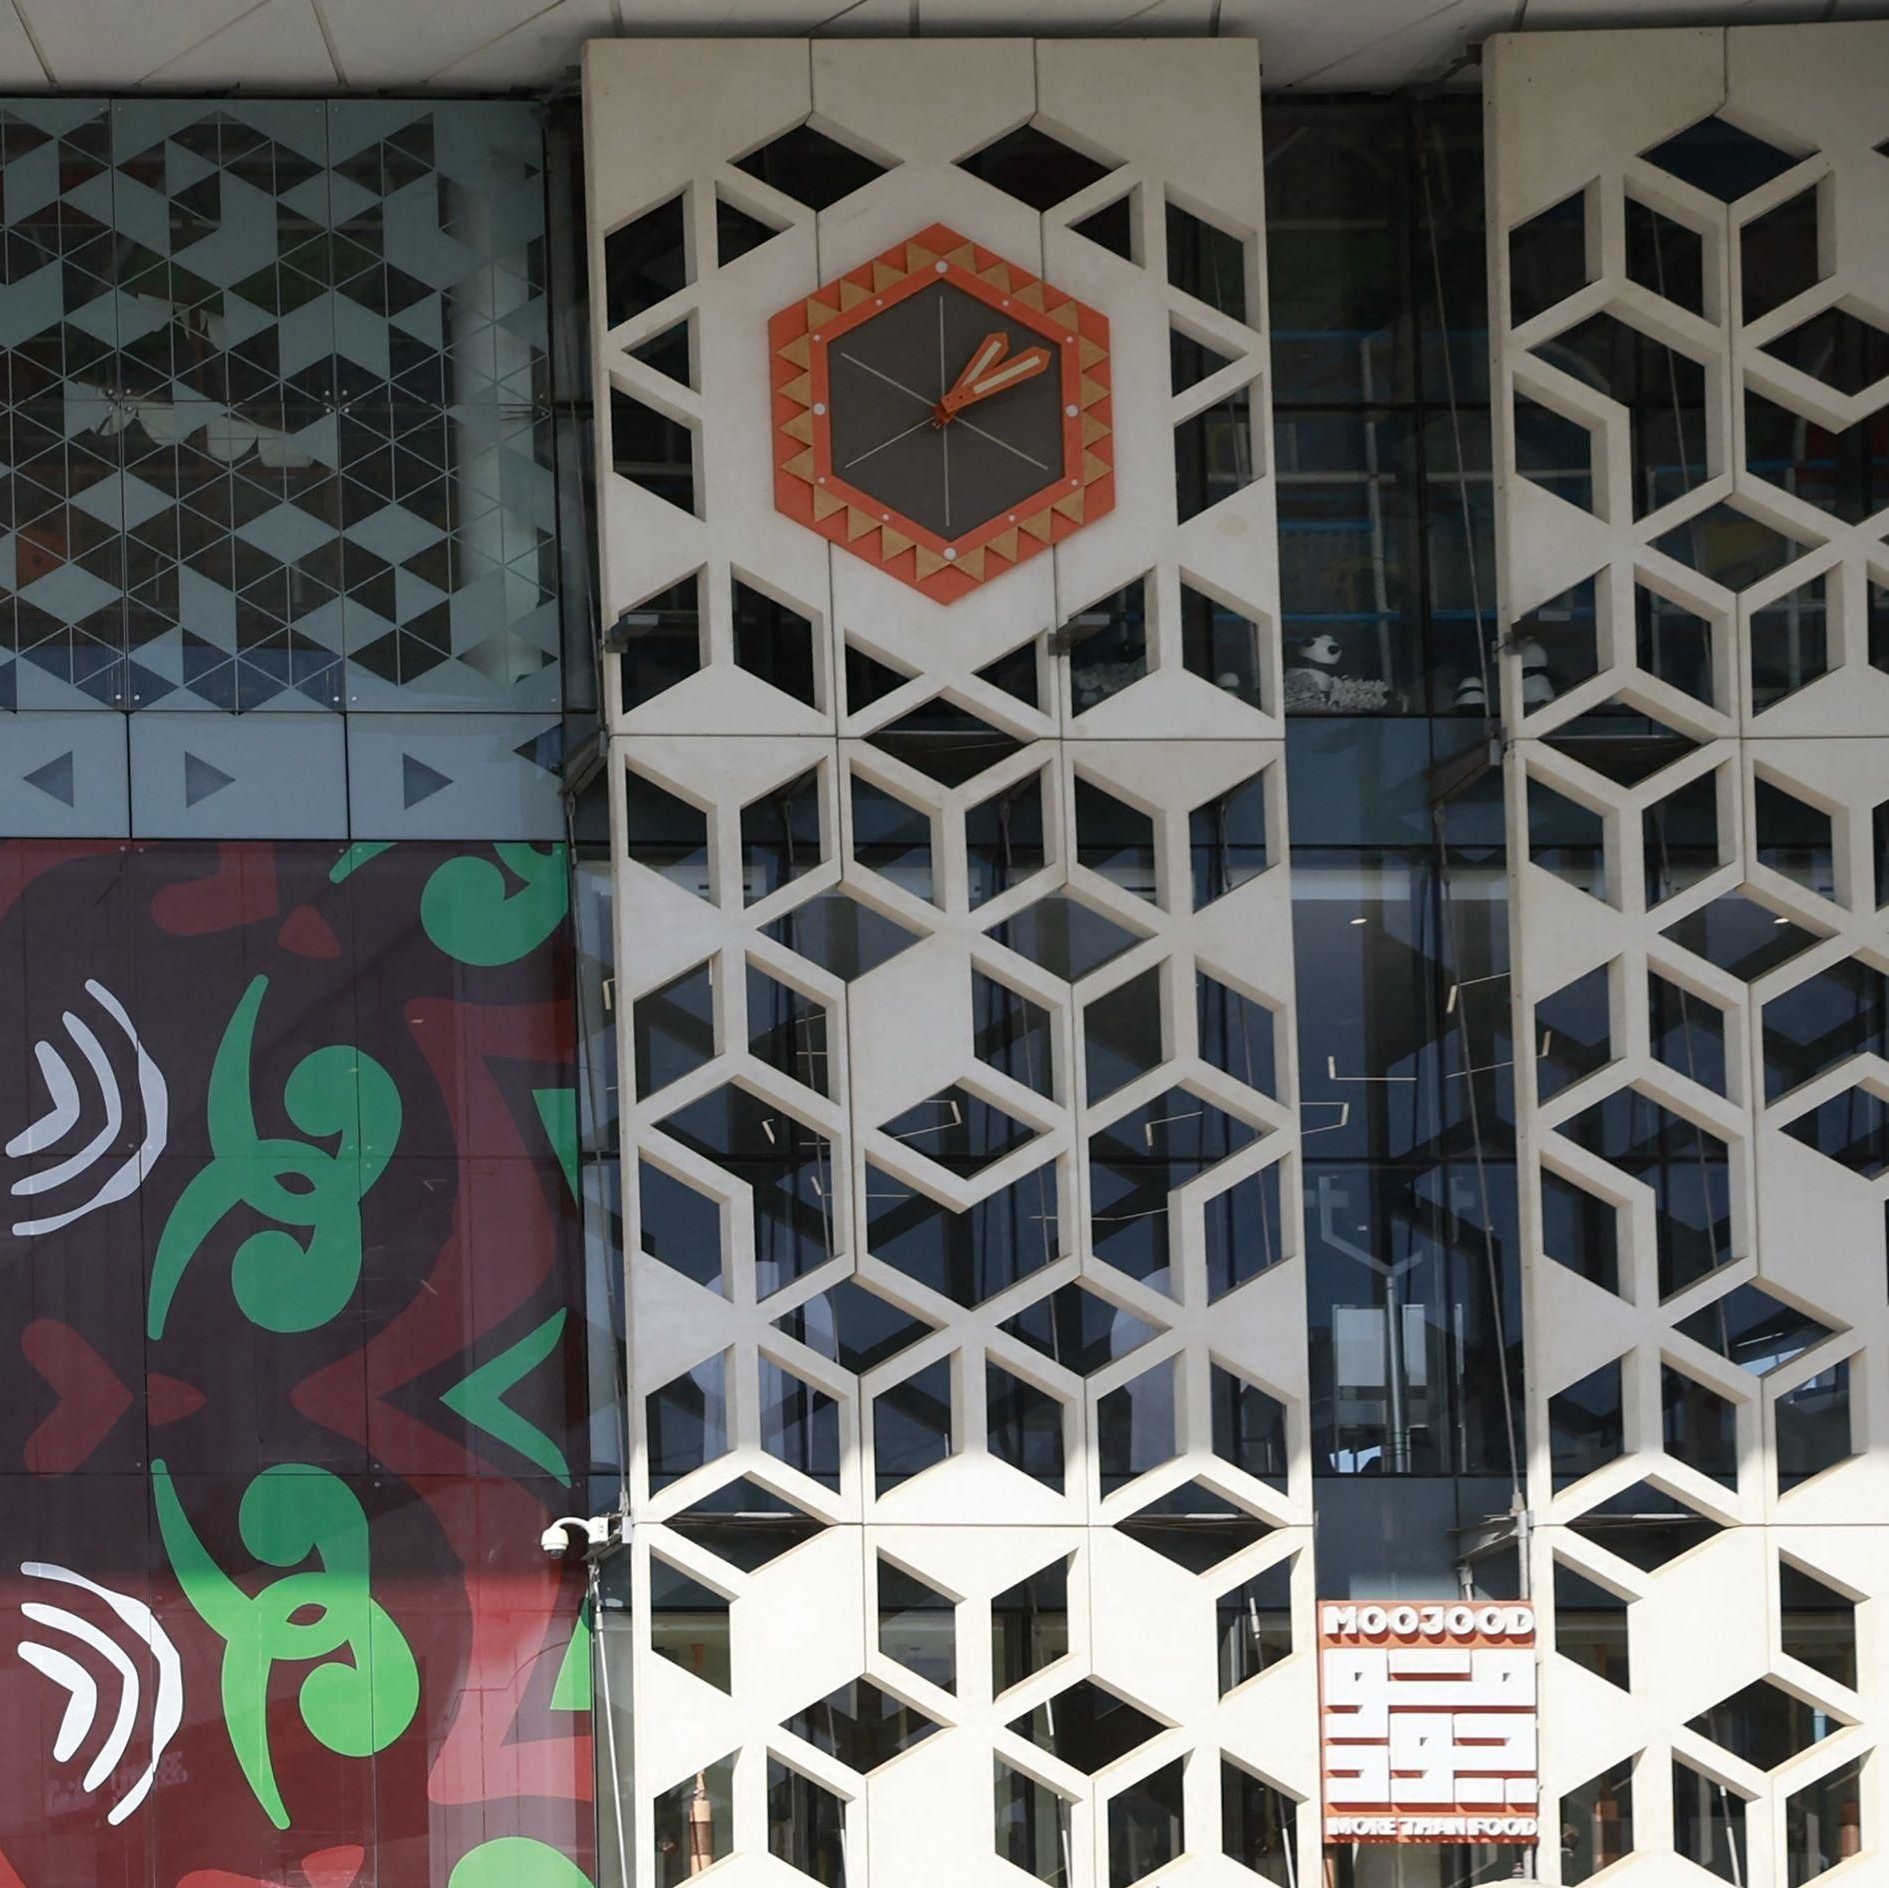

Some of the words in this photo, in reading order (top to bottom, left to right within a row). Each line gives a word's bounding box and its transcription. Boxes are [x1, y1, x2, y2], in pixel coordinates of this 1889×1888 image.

[1323, 1604, 1536, 1637] MOOJOOD
[1326, 1816, 1397, 1836] MORE
[1398, 1816, 1466, 1836] THAN
[1466, 1816, 1539, 1836] FOOD
